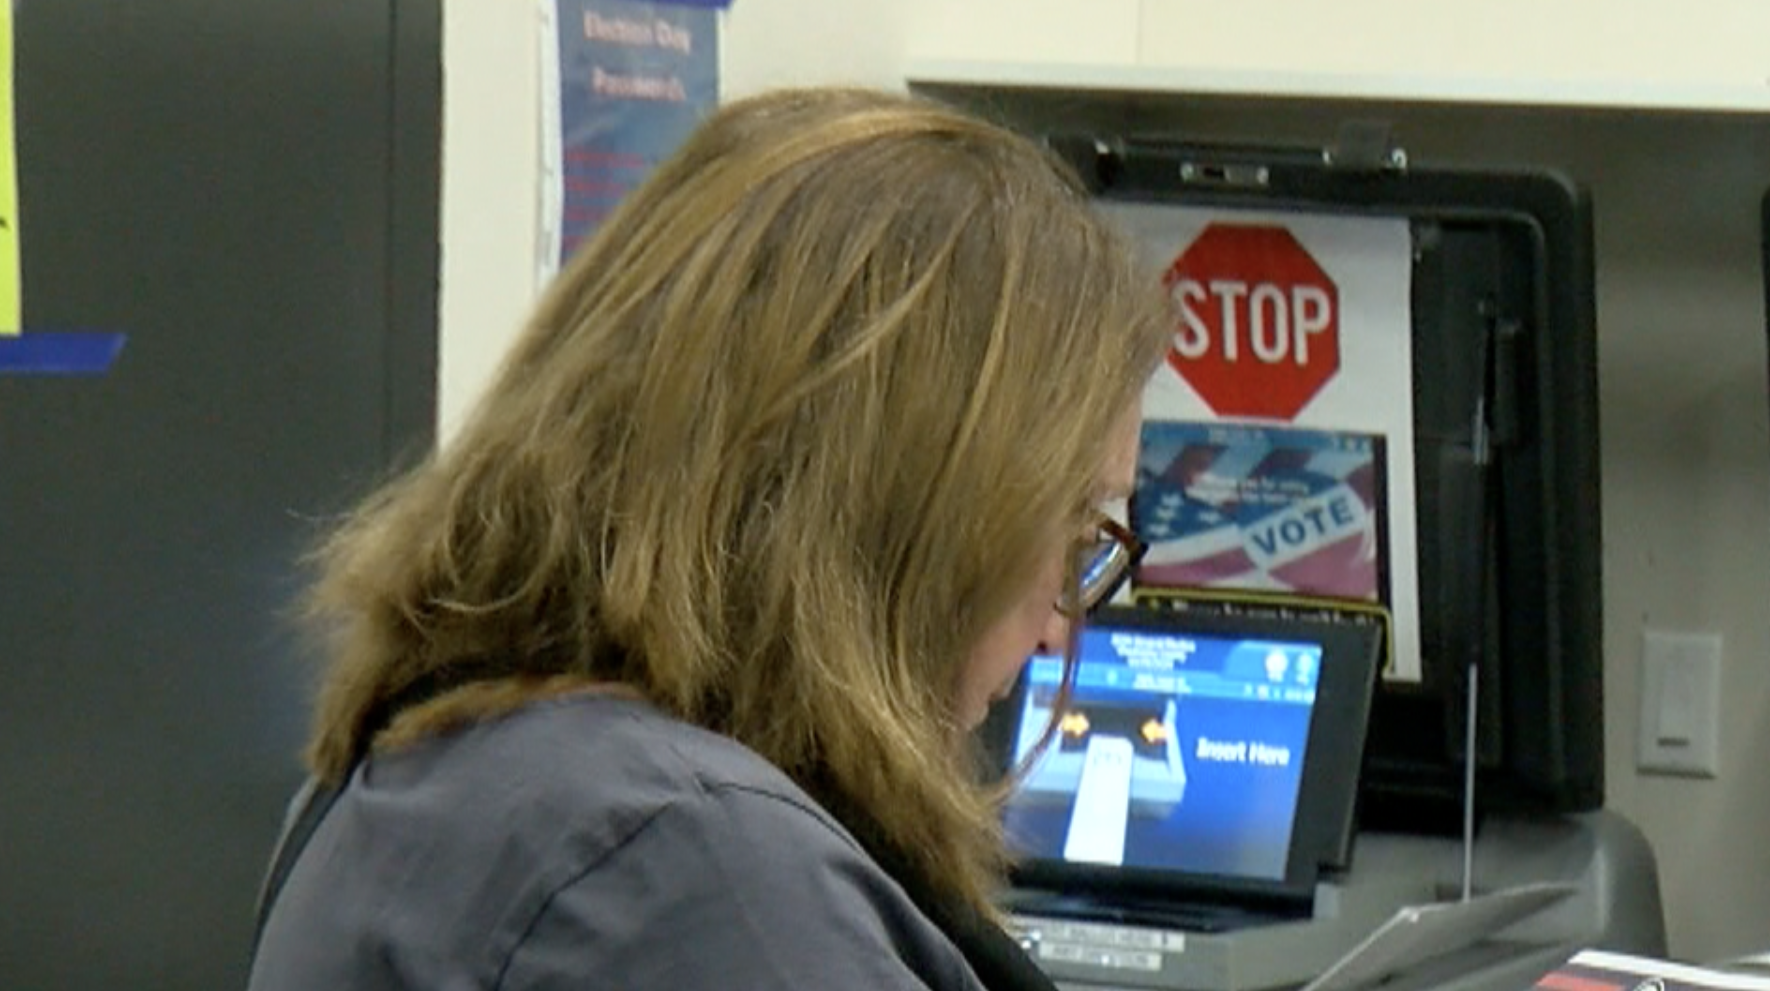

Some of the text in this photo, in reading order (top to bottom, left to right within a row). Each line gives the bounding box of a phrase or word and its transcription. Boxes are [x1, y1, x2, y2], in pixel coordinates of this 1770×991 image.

[1170, 279, 1331, 365] STOP
[1252, 496, 1354, 556] VOTE
[1196, 737, 1290, 766] Insert Here
